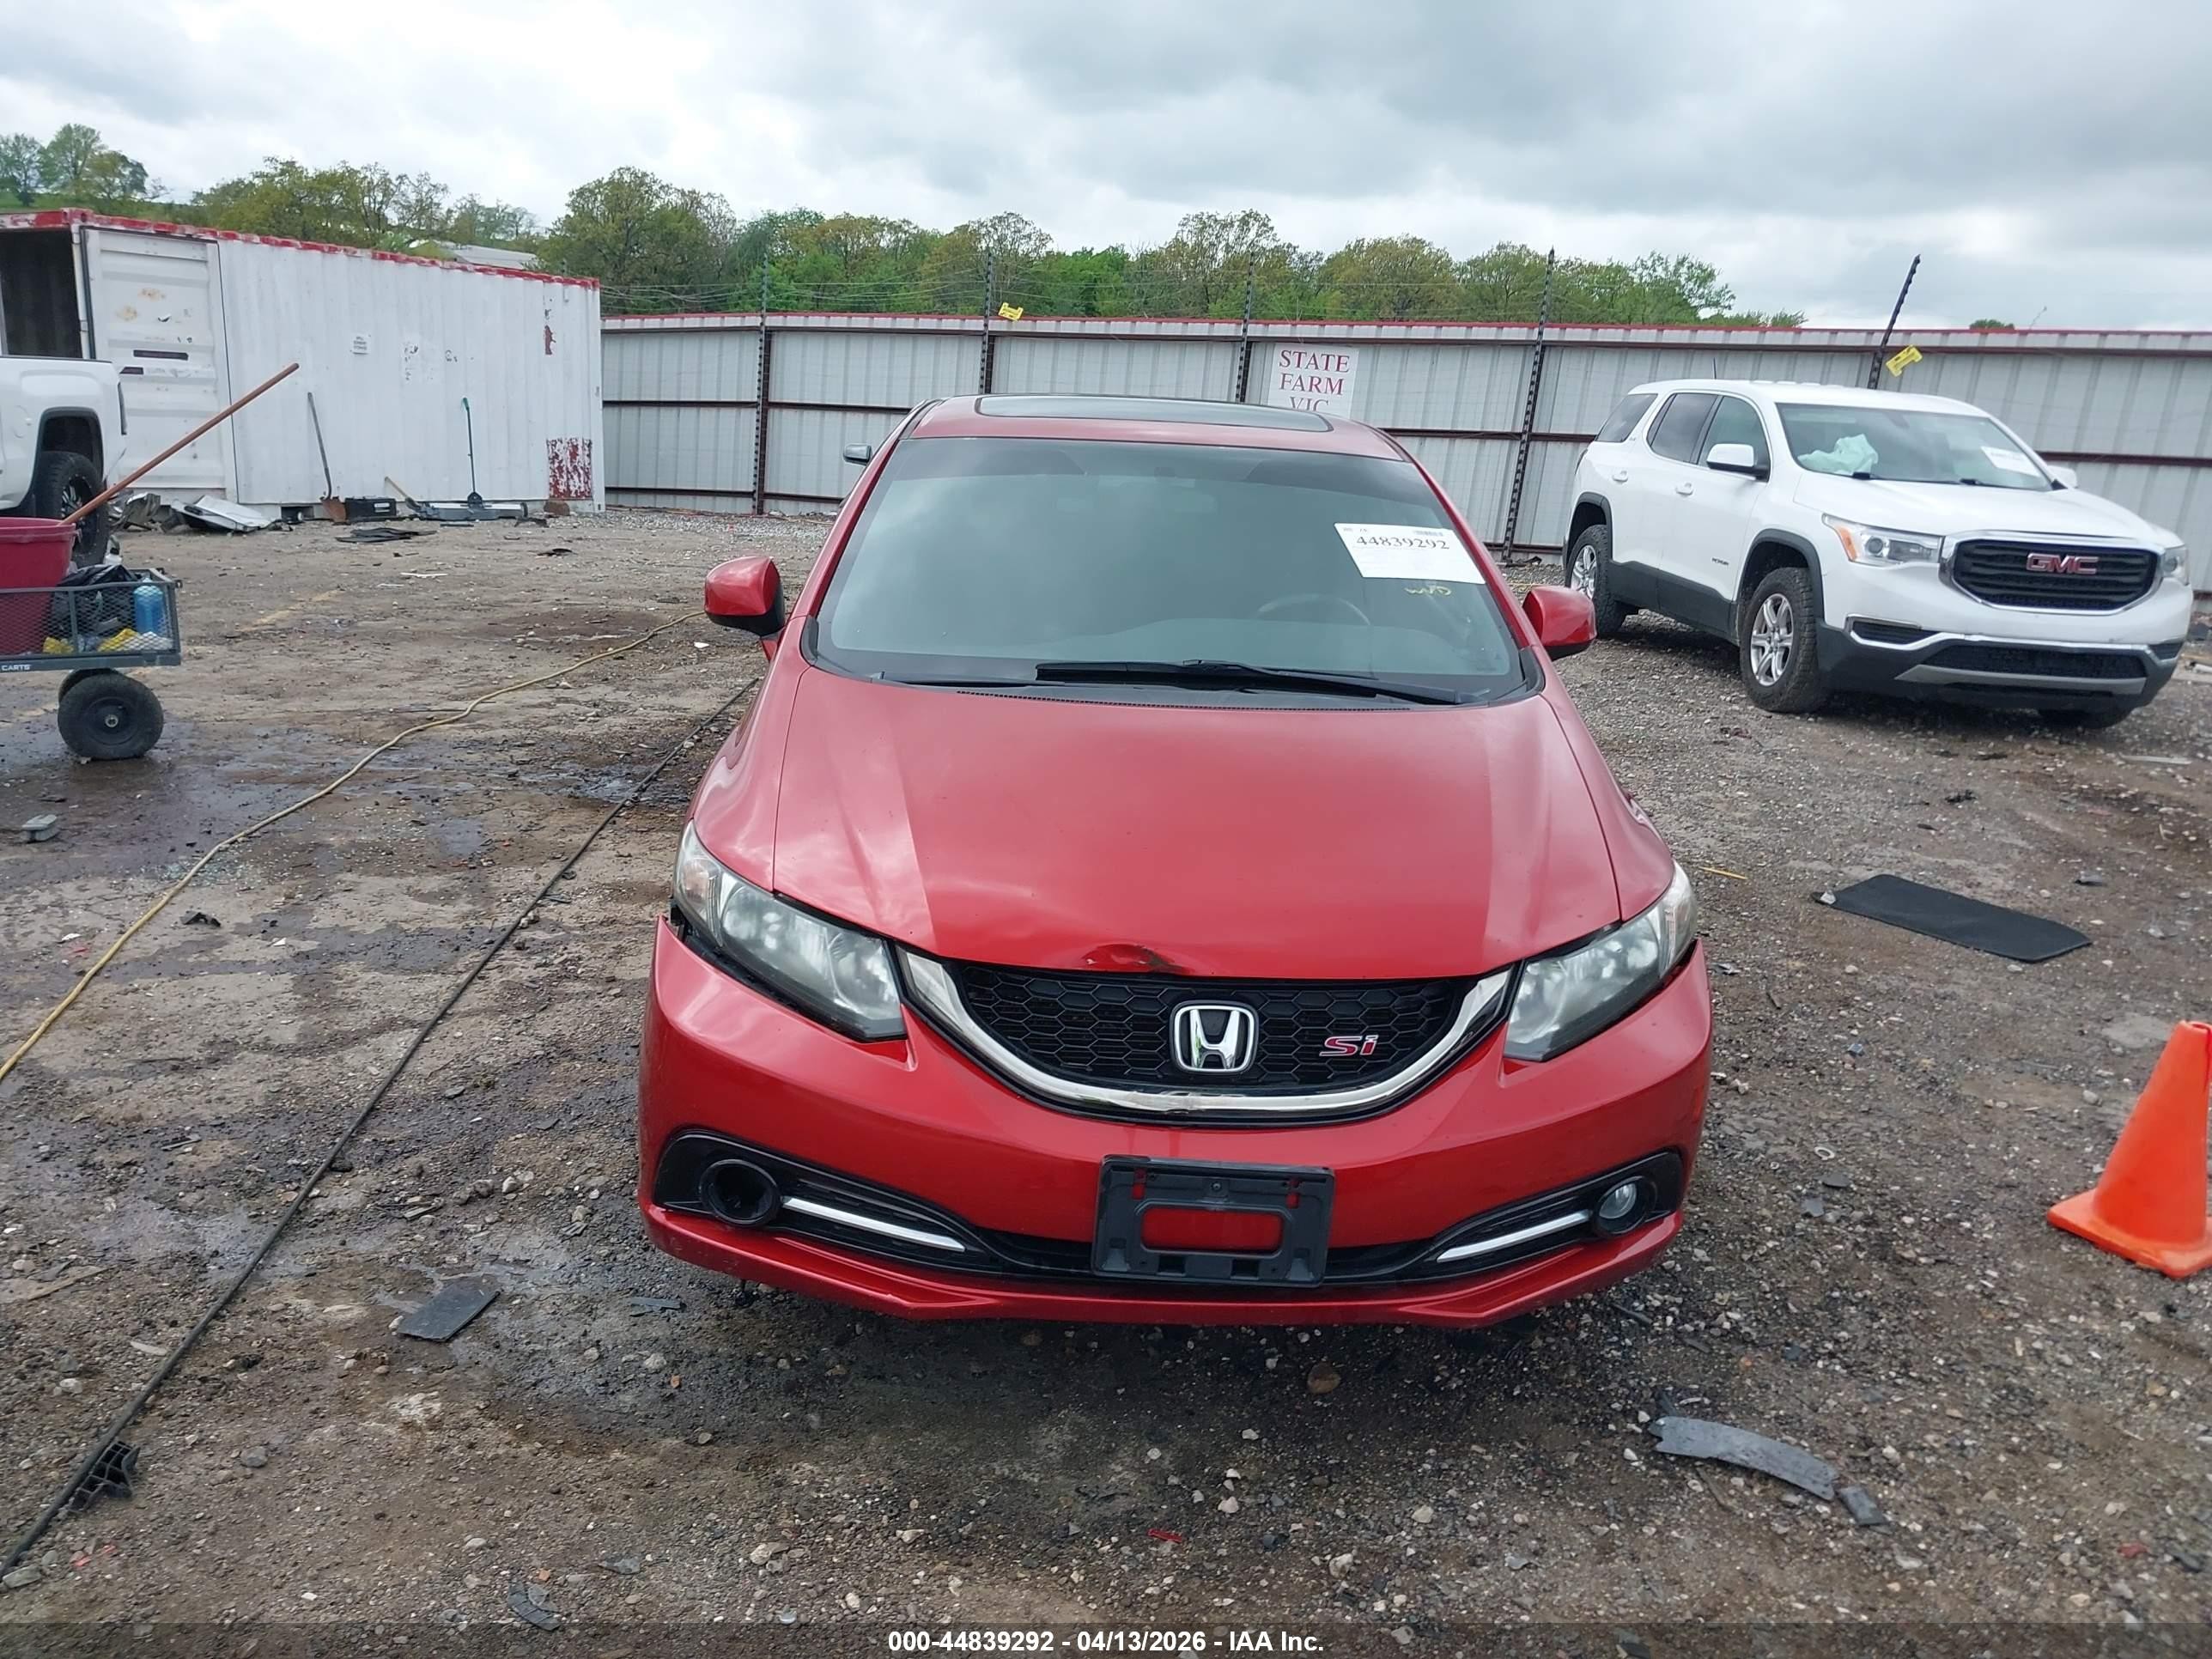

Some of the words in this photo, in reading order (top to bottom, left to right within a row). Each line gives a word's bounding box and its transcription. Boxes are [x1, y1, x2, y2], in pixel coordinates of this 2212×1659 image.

[1279, 349, 1350, 373] STATE
[1279, 372, 1345, 396] FARM
[1356, 536, 1450, 550] 44839292
[2027, 553, 2099, 574] GMC
[1319, 1034, 1379, 1057] Si
